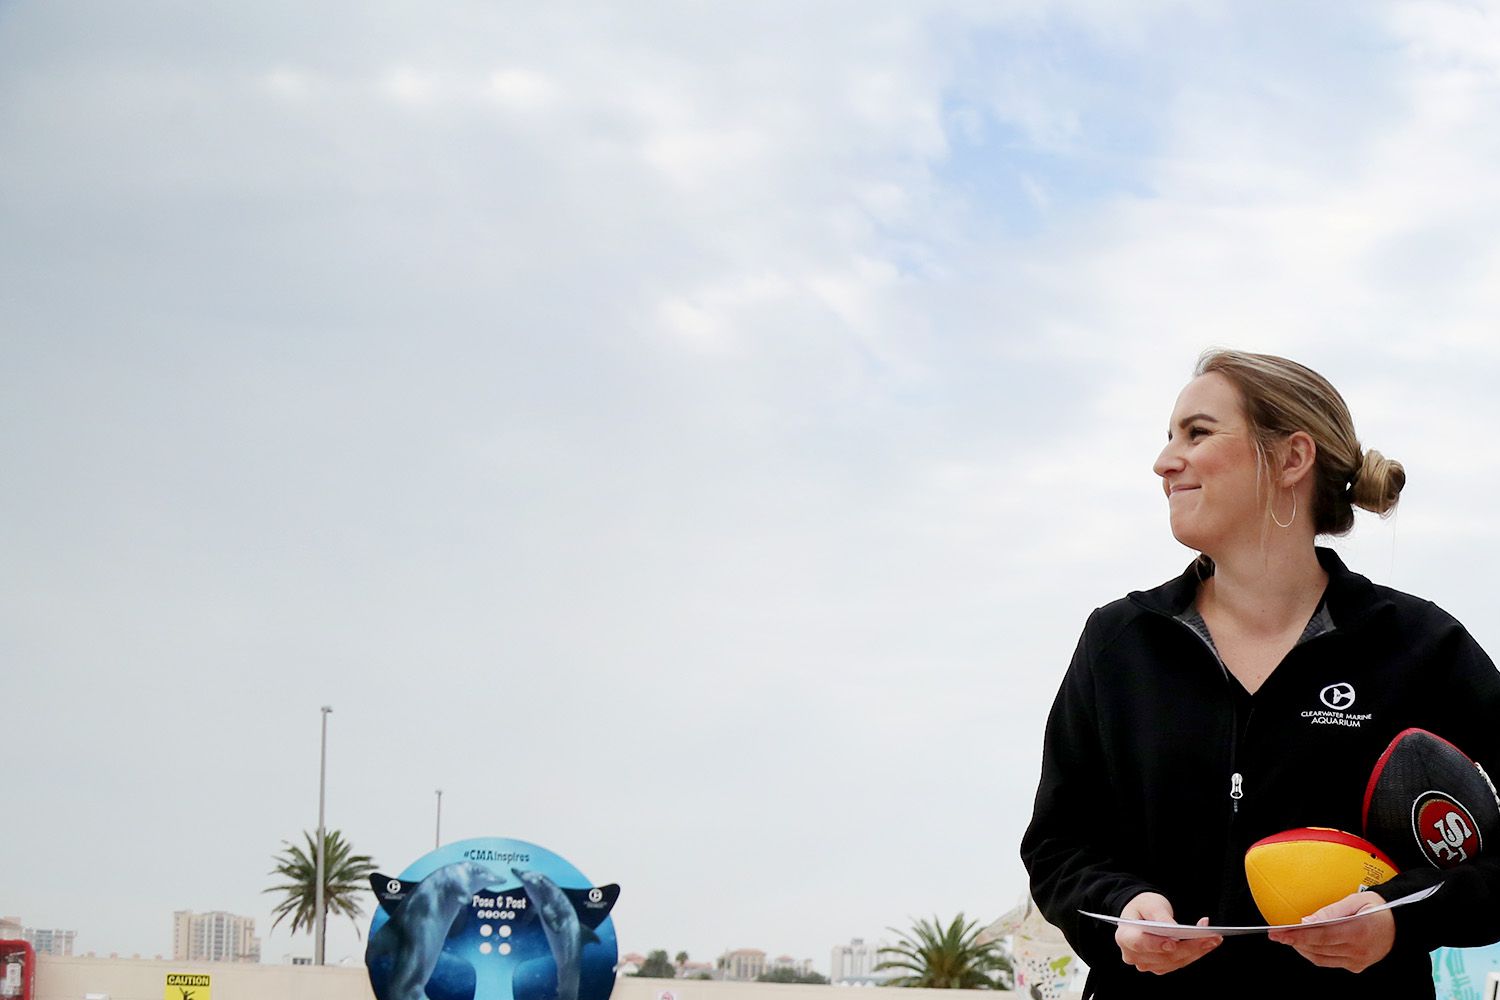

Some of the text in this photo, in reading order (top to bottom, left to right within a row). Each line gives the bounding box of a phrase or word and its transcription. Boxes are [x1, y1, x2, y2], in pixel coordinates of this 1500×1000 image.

[1301, 710, 1372, 721] CLEARWATER MARINE
[1311, 716, 1361, 728] AQUARIUM
[473, 895, 494, 908] Pose
[506, 896, 526, 909] Post
[168, 975, 208, 986] CAUTION
